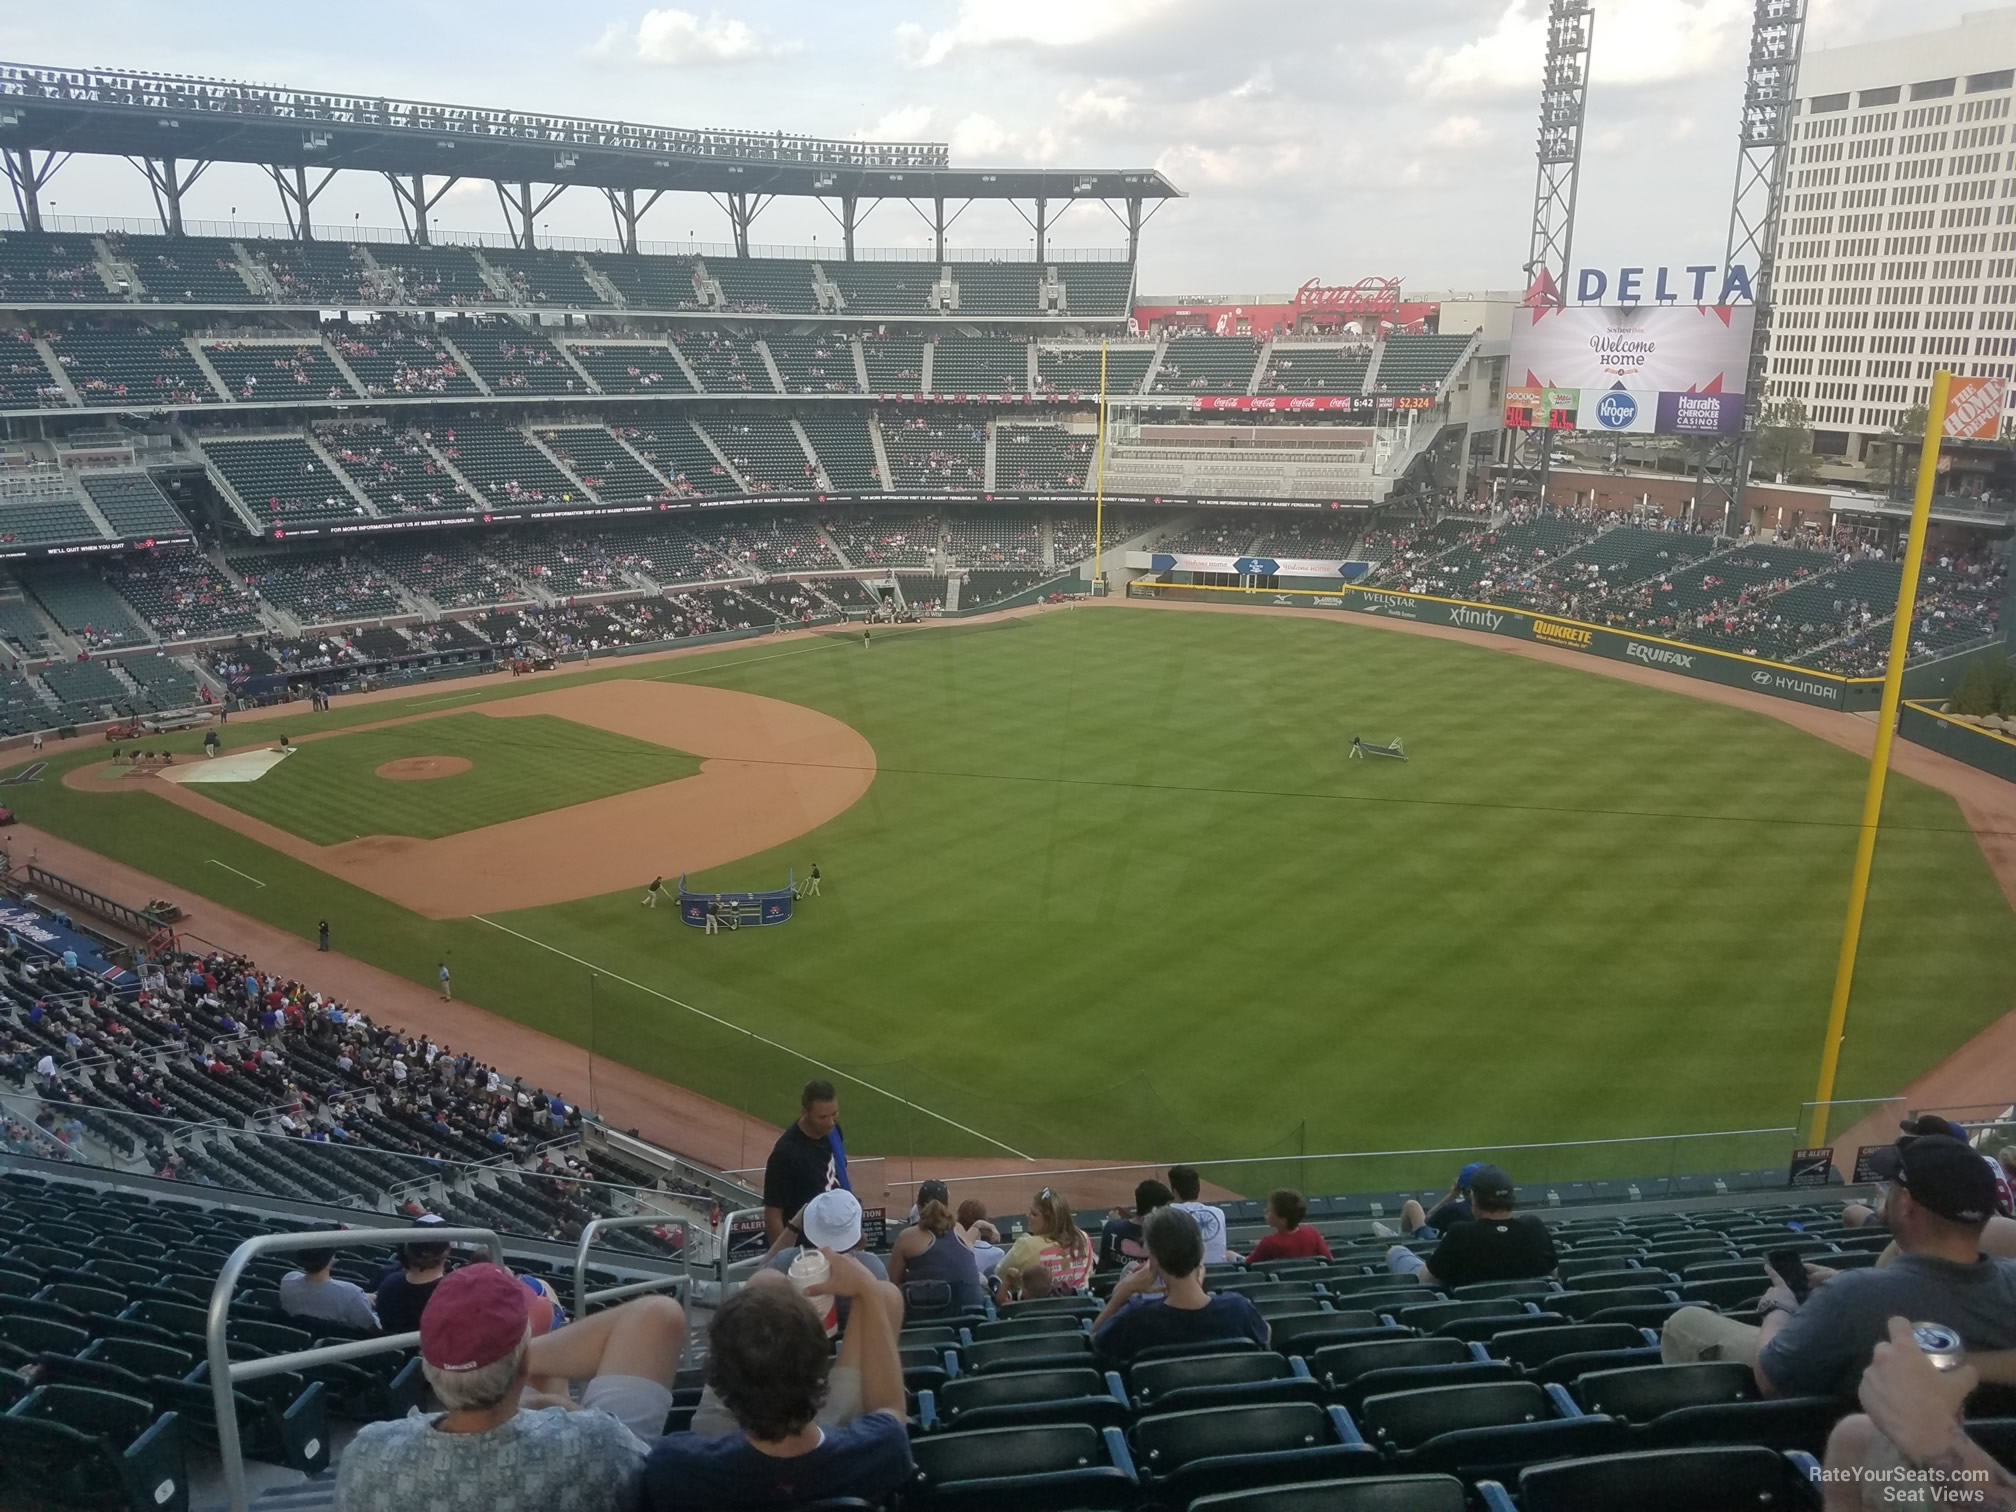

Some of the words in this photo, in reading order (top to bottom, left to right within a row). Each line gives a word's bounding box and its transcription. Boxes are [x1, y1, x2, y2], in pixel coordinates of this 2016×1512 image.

[1577, 264, 1754, 301] DELTA
[1590, 335, 1656, 352] Welcome
[1353, 398, 1374, 407] 6:42
[1400, 397, 1429, 408] $2,324
[1678, 396, 1720, 410] Harrah's
[1951, 384, 1977, 407] THE
[1600, 397, 1634, 425] Kroger
[1677, 409, 1719, 418] CHEROKEE
[1943, 377, 2005, 436] HOME
[1677, 417, 1718, 426] CASINOS
[1963, 401, 2001, 437] DEPOT
[1363, 592, 1416, 608] WELLSTAR
[1449, 606, 1504, 631] xfinity
[1533, 620, 1592, 644] QUIKRETE
[1626, 642, 1693, 669] EQUIFAX
[1775, 676, 1837, 700] HYUNDAI
[1808, 1149, 1831, 1158] ALERT
[741, 1221, 766, 1230] ALERT
